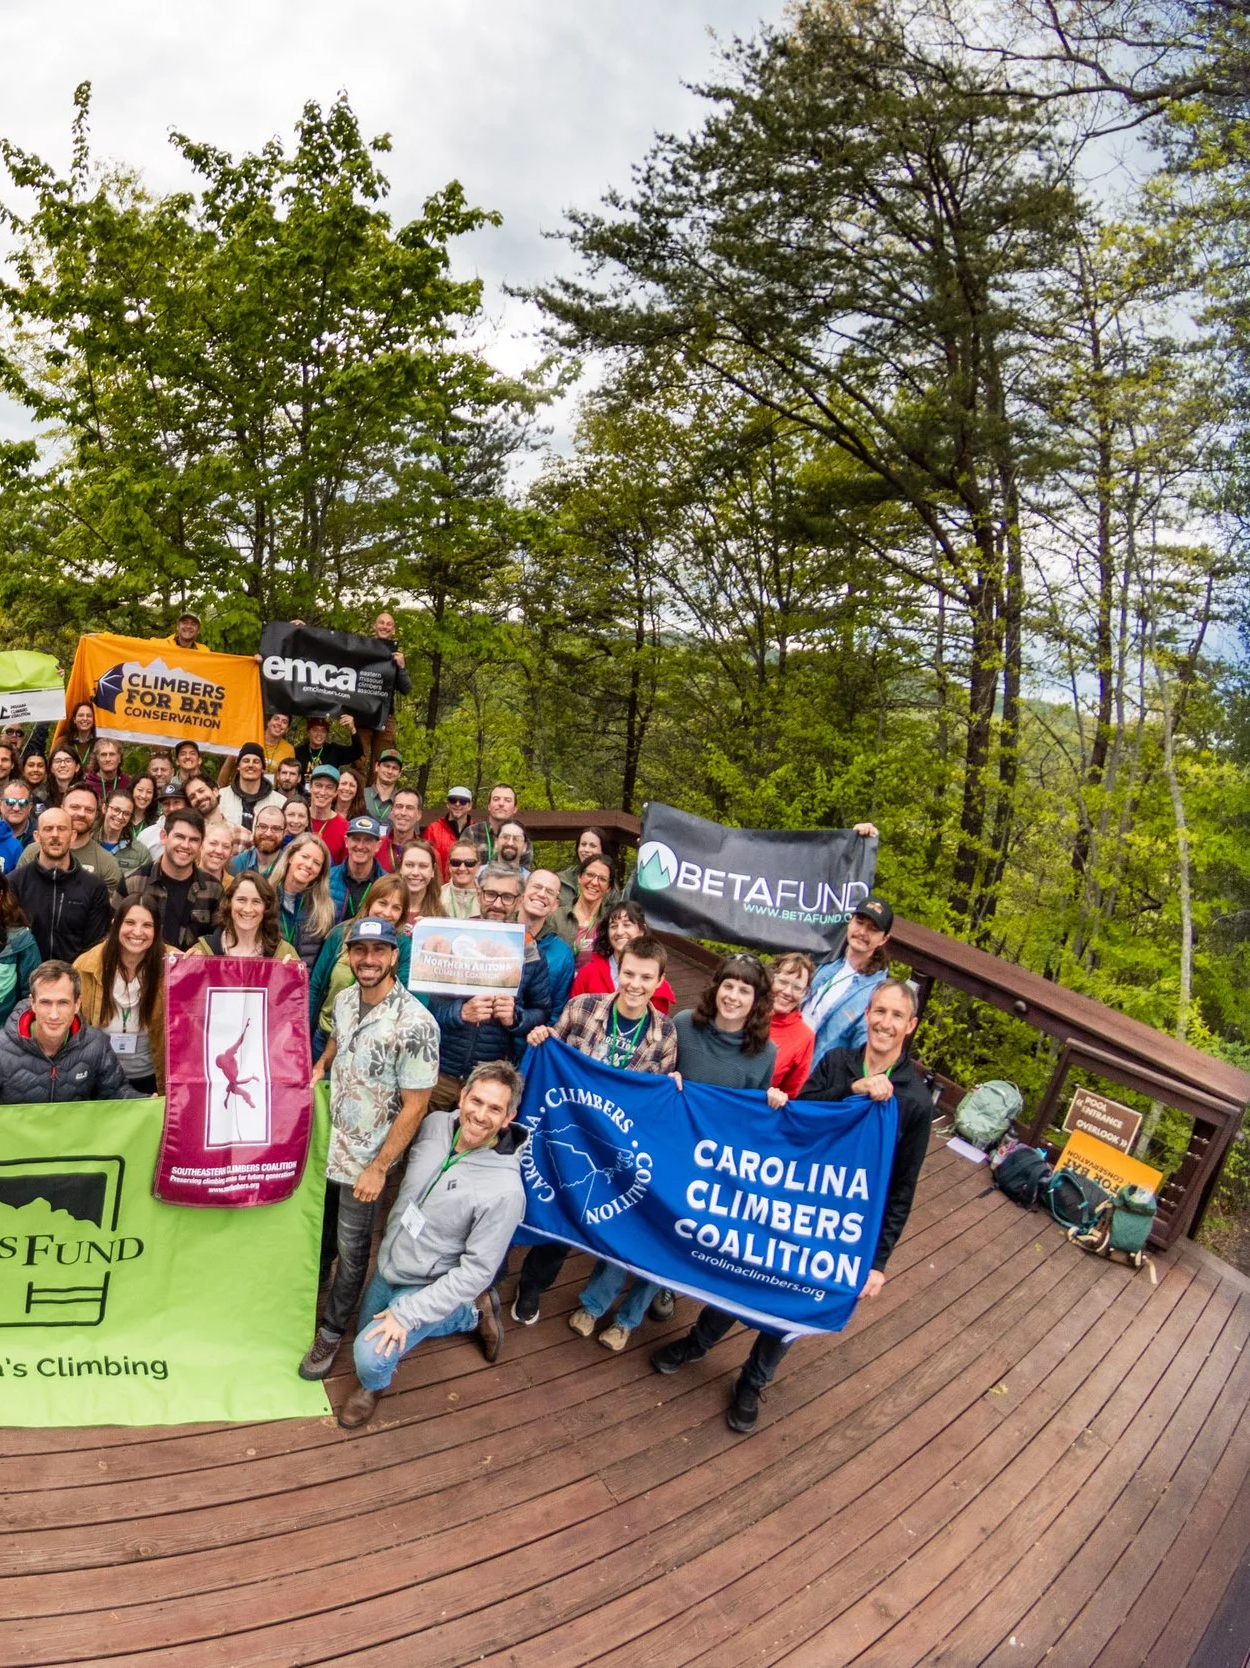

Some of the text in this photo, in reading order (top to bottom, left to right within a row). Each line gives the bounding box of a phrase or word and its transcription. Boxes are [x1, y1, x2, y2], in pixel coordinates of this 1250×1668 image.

[128, 673, 226, 701] CLIMBERS
[262, 655, 357, 692] emca
[126, 688, 223, 718] FOR BAT
[302, 685, 351, 699] emclimbers.com
[124, 706, 221, 730] CONSERVATION
[676, 860, 869, 913] BETAFUND
[545, 1087, 634, 1134] CLIMBERS
[1081, 1105, 1124, 1129] ENTRANCE
[1085, 1096, 1108, 1113] POOL
[1075, 1119, 1120, 1144] OVERLOOK
[171, 1166, 226, 1176] SOUTHEASTERN
[261, 1160, 297, 1171] COALITION
[693, 1139, 870, 1201] CAROLINA
[1067, 1150, 1124, 1184] CONSERVATION
[586, 1152, 653, 1225] COALITION
[686, 1179, 865, 1244] CLIMBERS
[22, 1233, 145, 1267] FUND
[673, 1218, 862, 1288] COALITION
[691, 1249, 826, 1302] carolinaclimbers.org
[36, 1355, 169, 1381] Climbing
